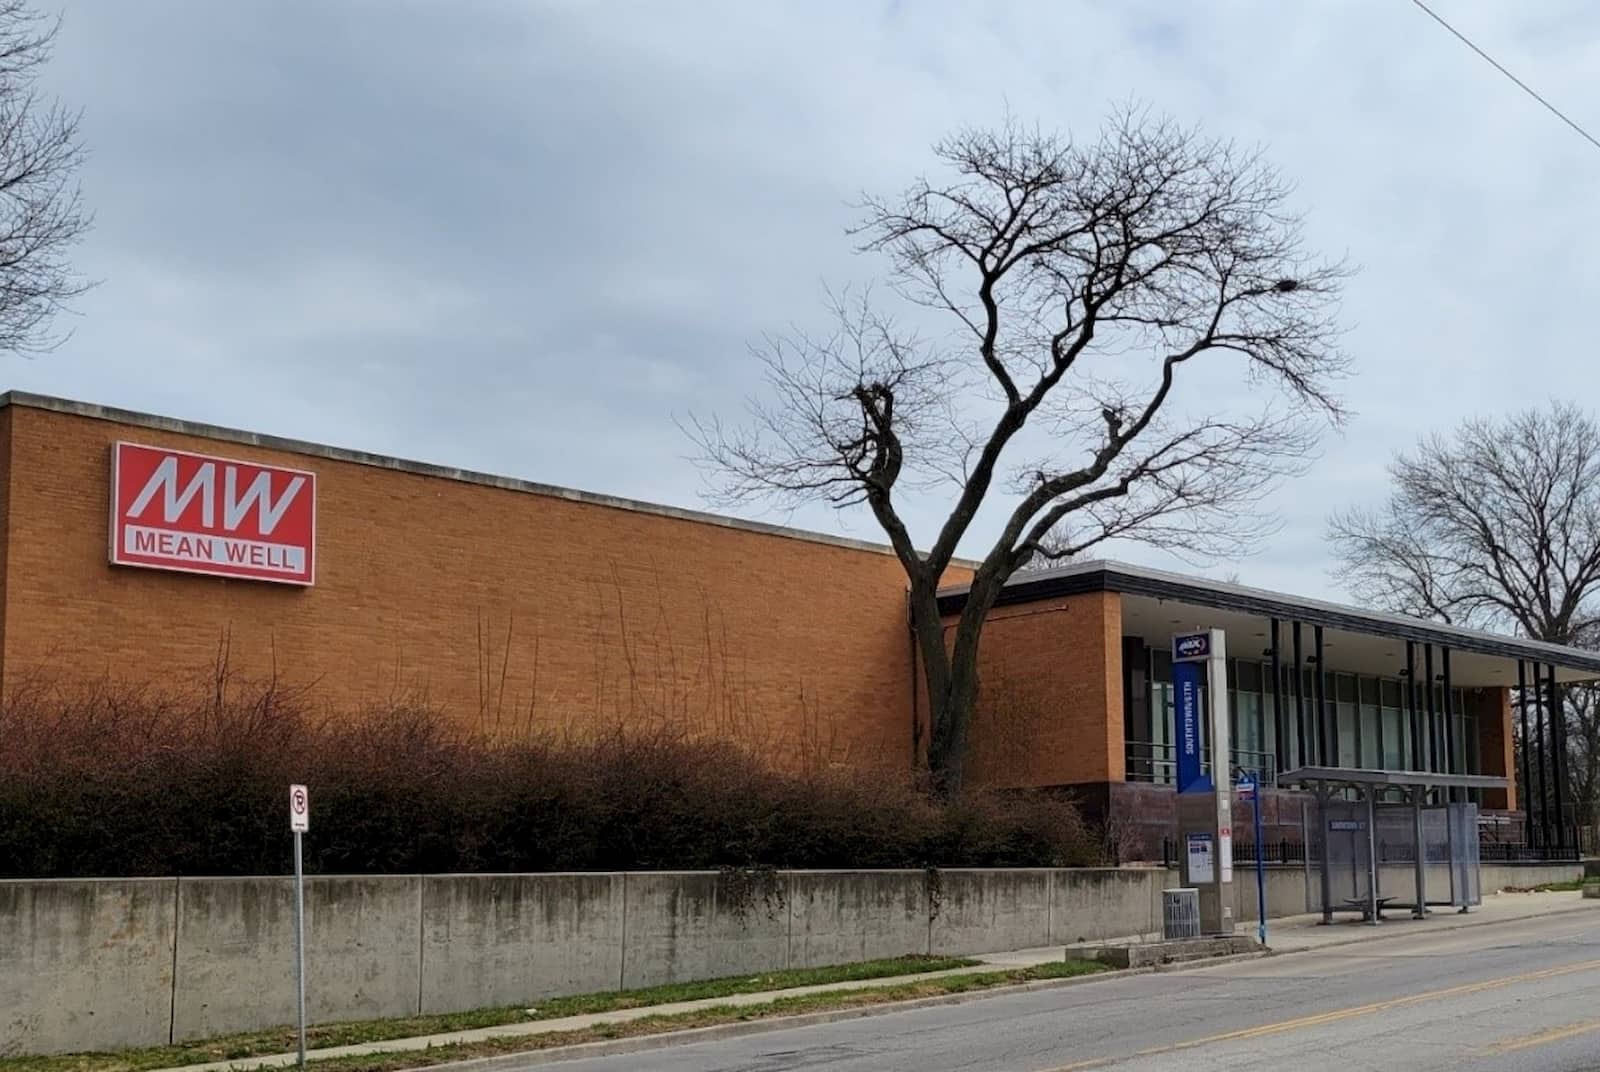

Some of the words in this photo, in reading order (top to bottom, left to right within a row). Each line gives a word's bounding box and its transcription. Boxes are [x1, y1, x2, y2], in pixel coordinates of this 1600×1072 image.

[126, 456, 305, 535] MW
[135, 530, 212, 560] MEAN
[225, 541, 295, 569] WELL
